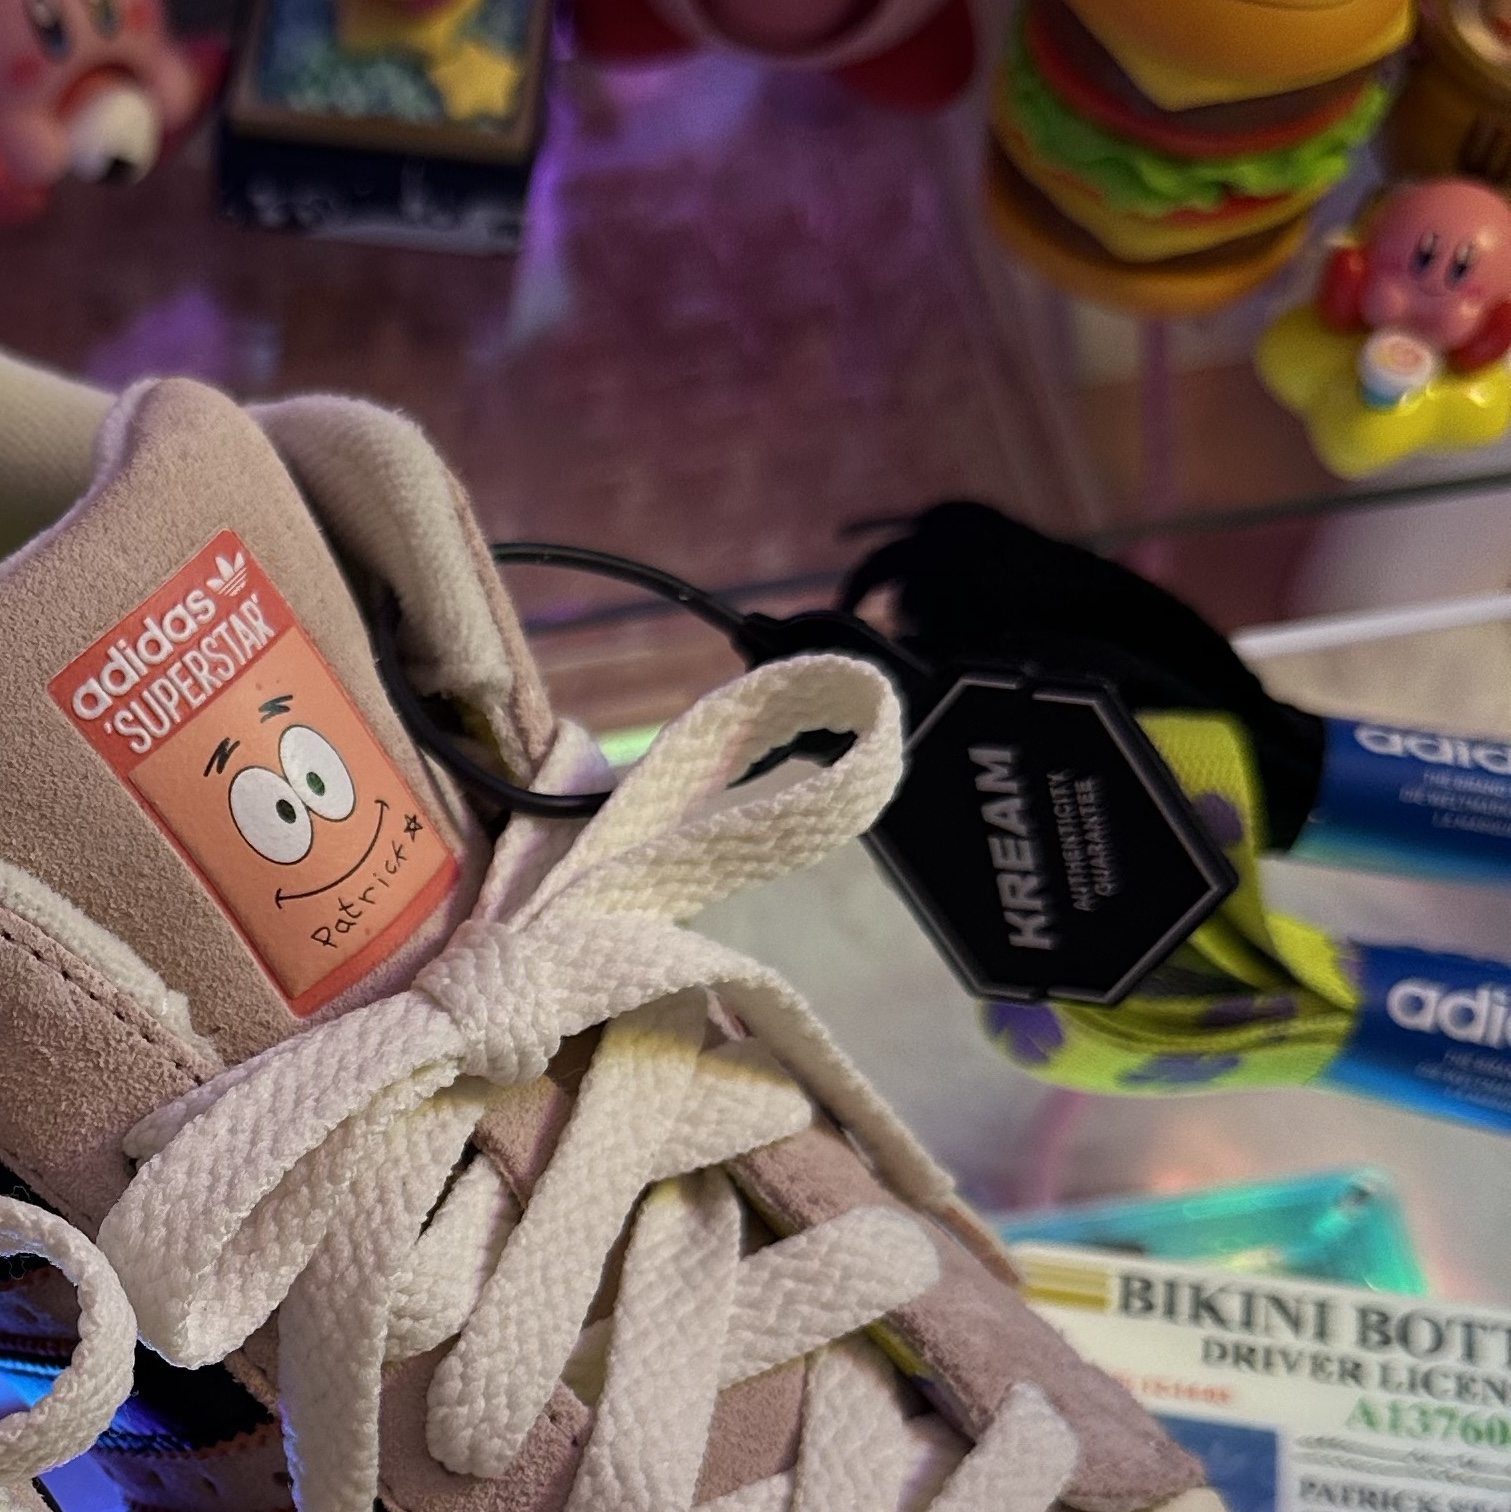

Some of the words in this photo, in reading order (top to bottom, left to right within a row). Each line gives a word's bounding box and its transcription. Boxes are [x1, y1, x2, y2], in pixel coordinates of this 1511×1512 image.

[72, 590, 216, 720] adidas
[967, 747, 1054, 949] KREAM
[1047, 768, 1098, 912] AUTHENTICITY
[1074, 777, 1118, 897] GUARANTEE
[311, 840, 408, 949] Patrick
[1387, 978, 1511, 1050] adi
[1118, 1273, 1336, 1346] BIKINI
[1201, 1335, 1365, 1388] DRIVER
